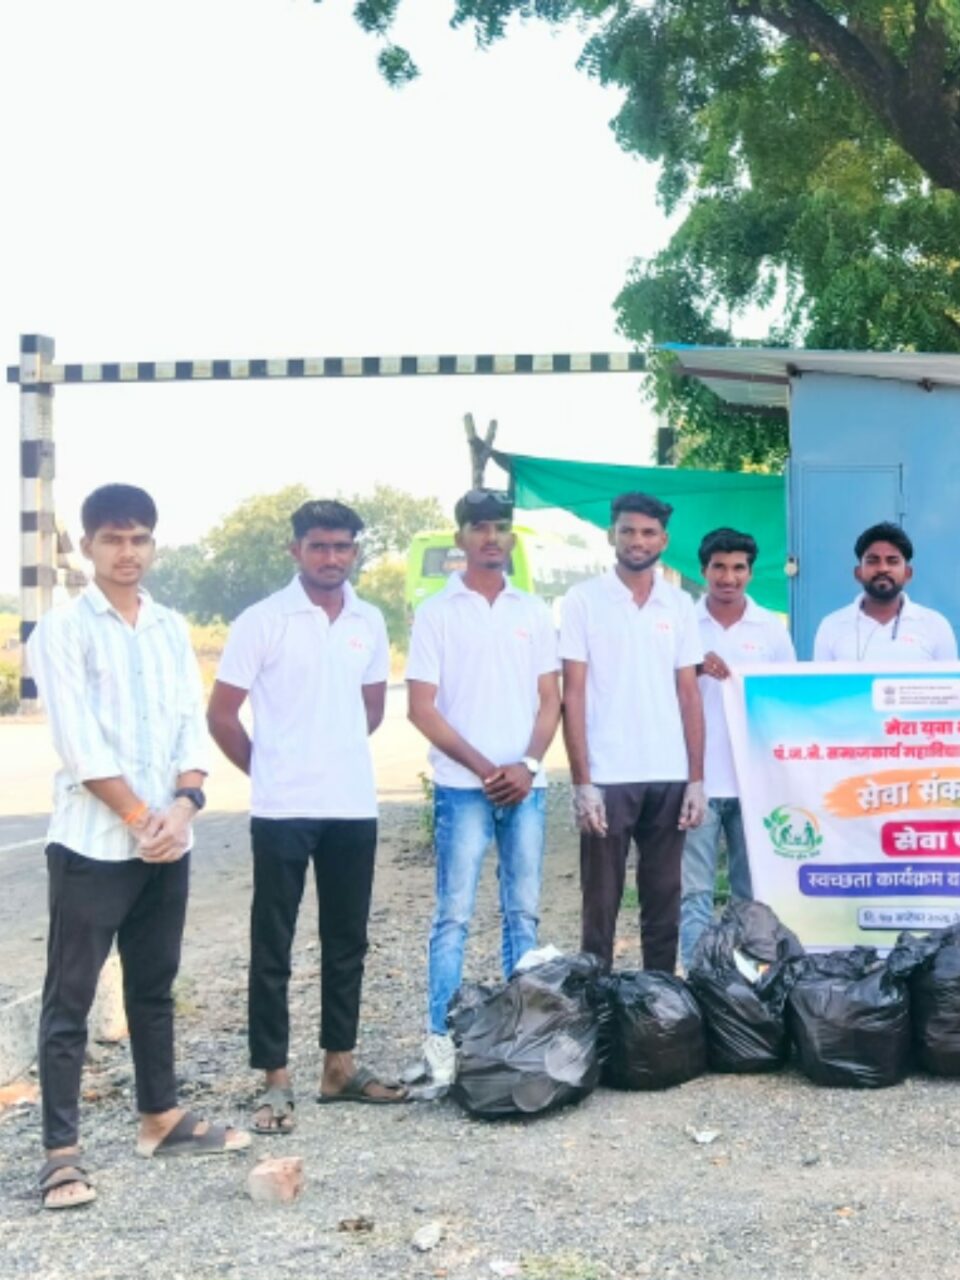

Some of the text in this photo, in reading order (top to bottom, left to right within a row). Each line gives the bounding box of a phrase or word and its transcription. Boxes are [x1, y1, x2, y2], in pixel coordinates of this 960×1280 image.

[921, 719, 953, 740] युवा
[856, 779, 911, 811] सेवा
[893, 824, 948, 850] सेवा
[806, 871, 872, 888] स्वच्छता
[876, 866, 943, 887] कार्यक्रम
[946, 872, 960, 887] व
